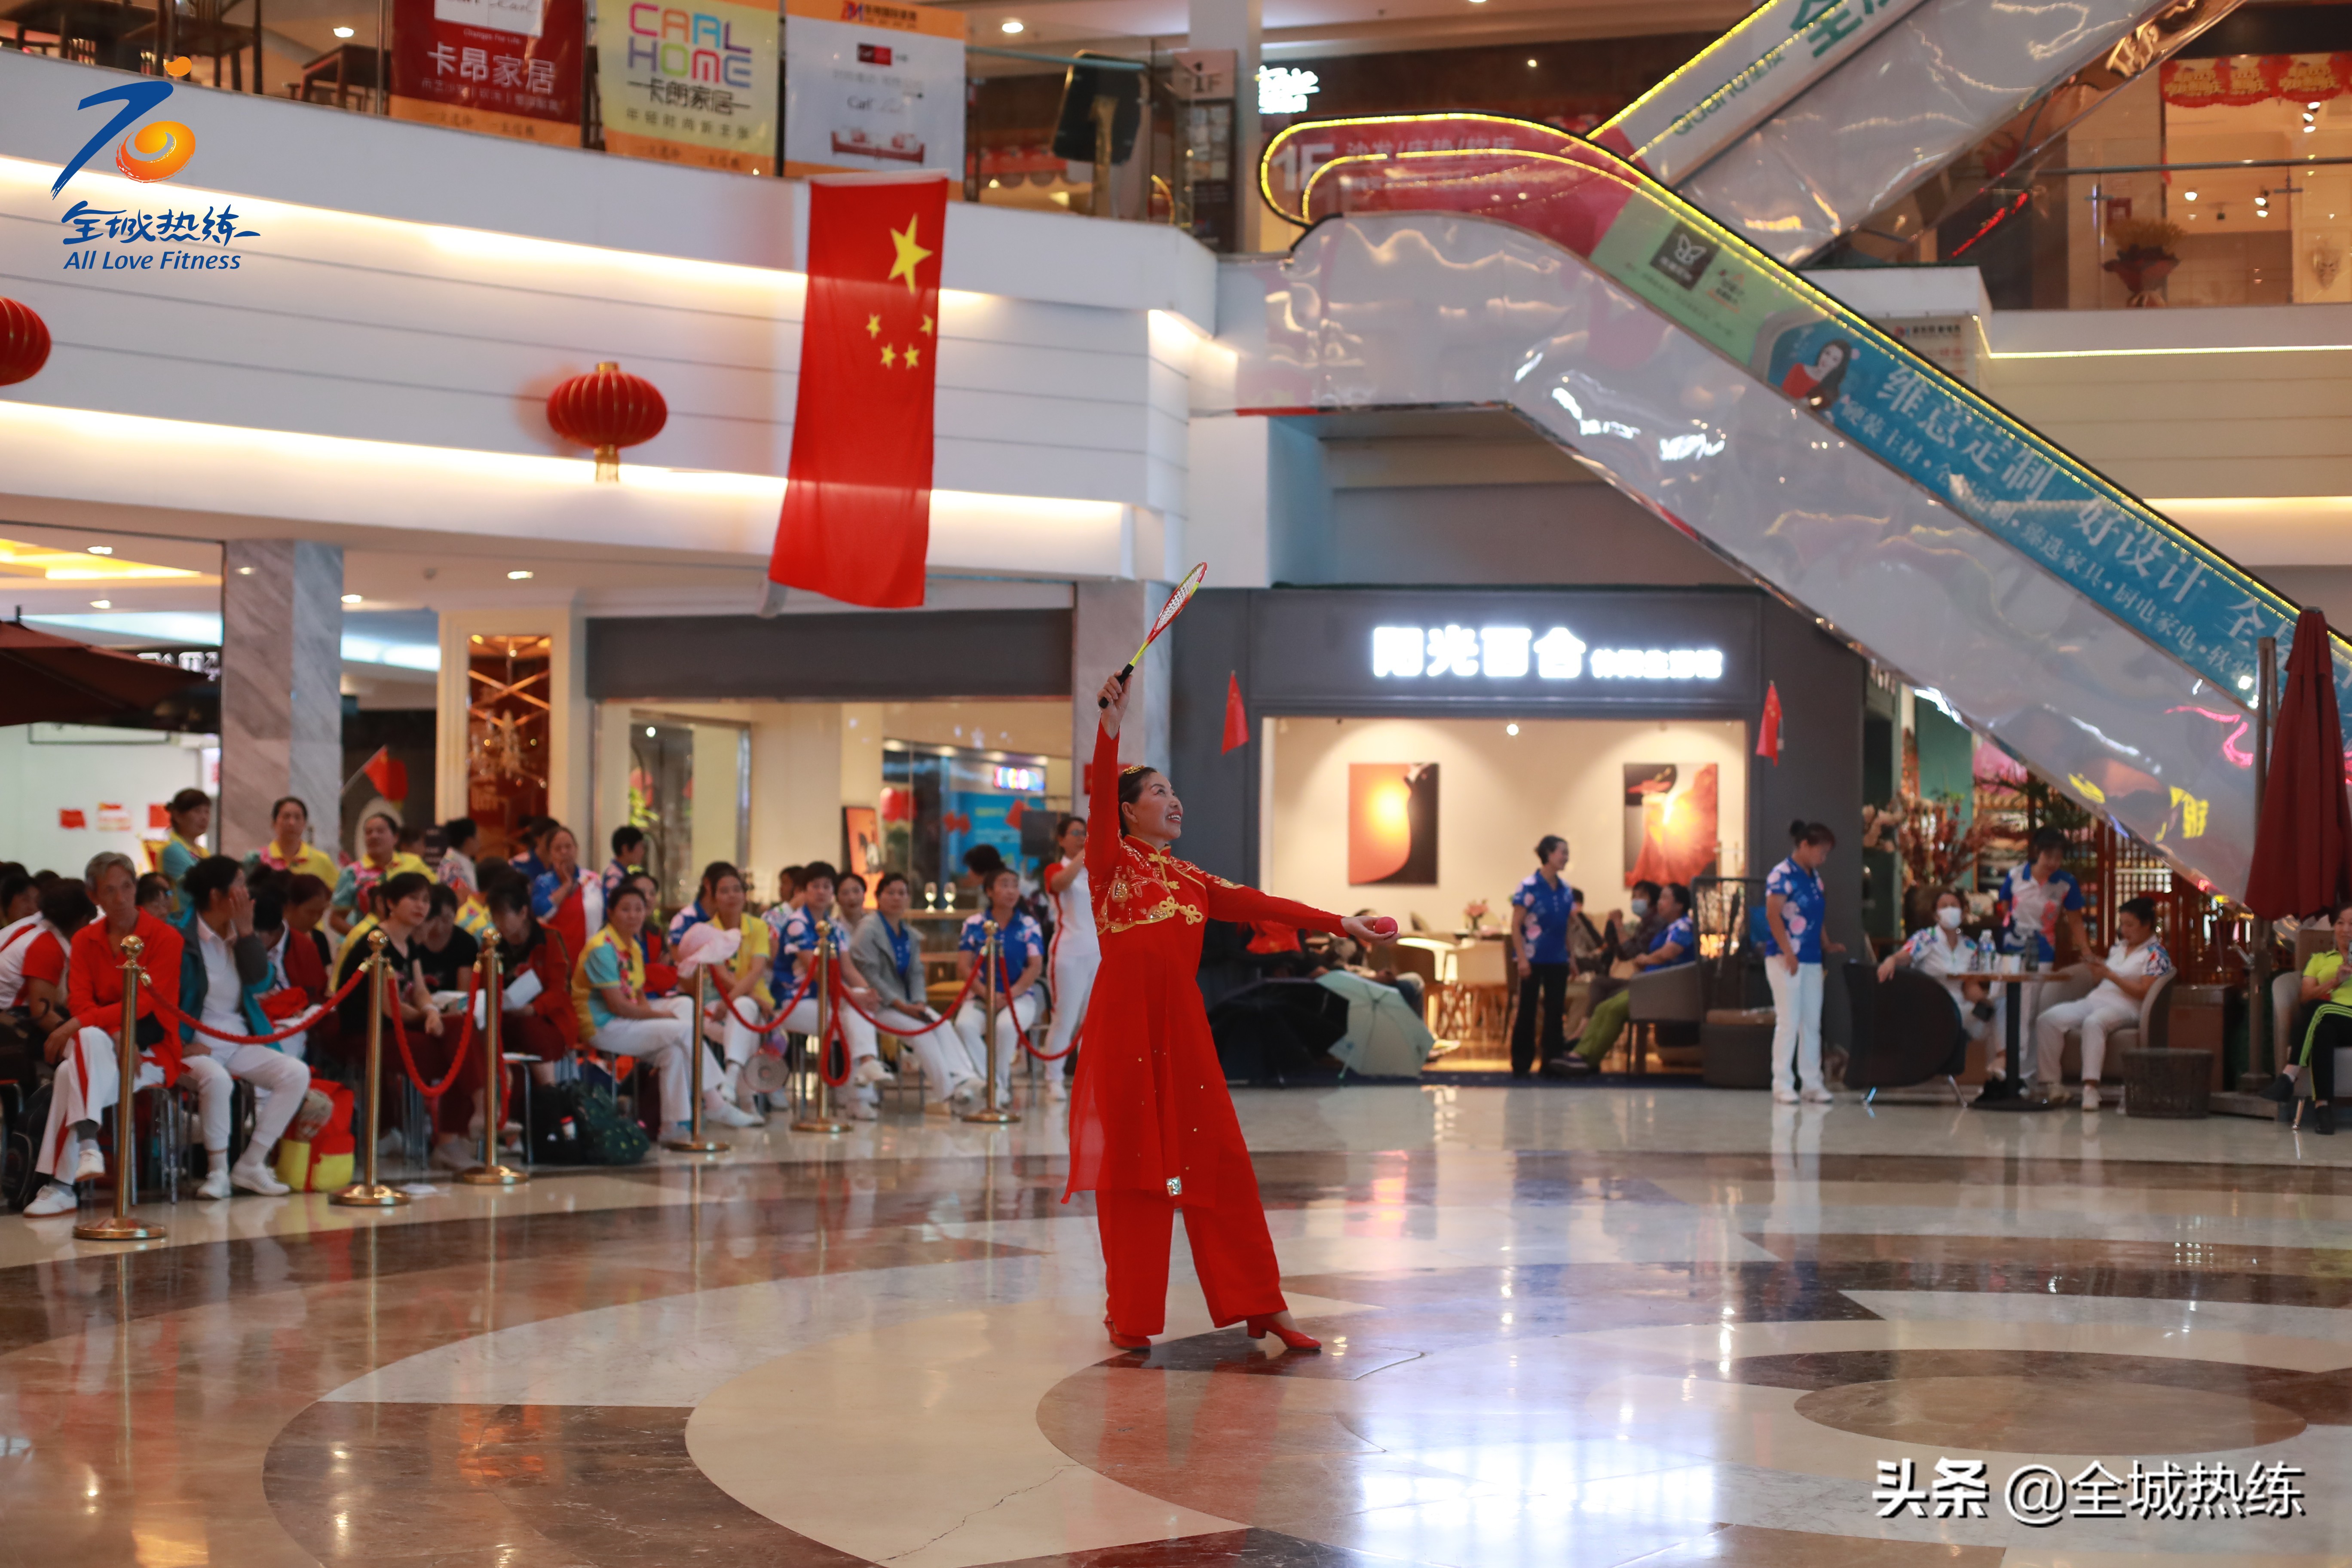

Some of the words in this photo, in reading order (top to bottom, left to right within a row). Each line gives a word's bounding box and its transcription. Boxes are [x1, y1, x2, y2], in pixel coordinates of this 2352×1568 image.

[1789, 0, 1892, 57] 全
[427, 41, 556, 95] 卡昂家居
[628, 36, 752, 88] HOME
[1877, 367, 2055, 503] 维意定制
[2073, 496, 2207, 603] 好设计
